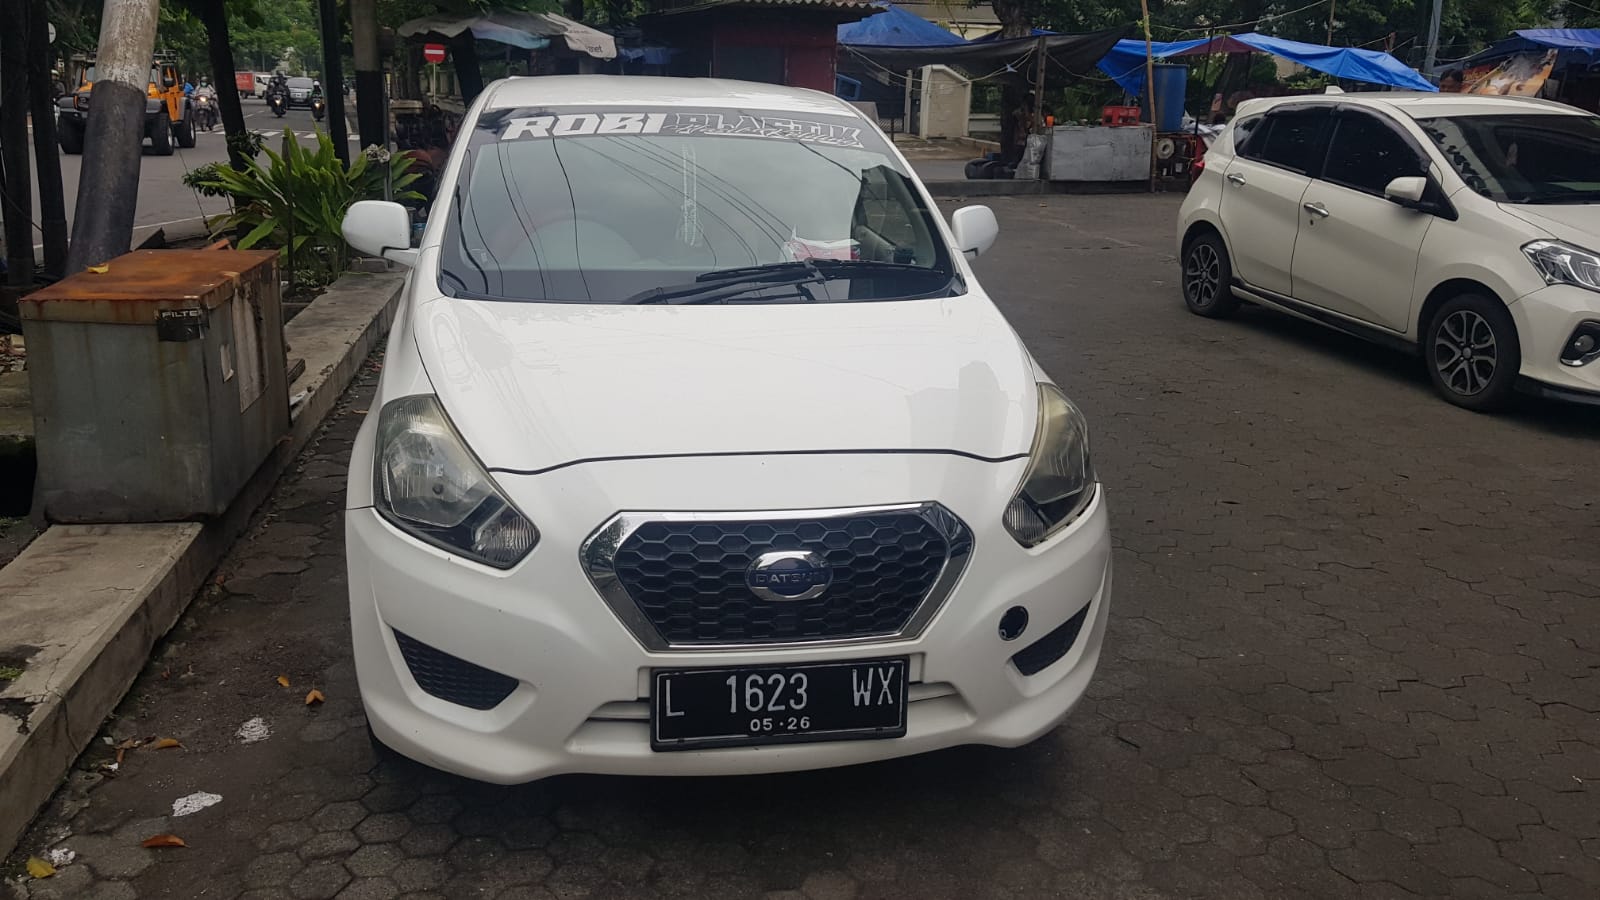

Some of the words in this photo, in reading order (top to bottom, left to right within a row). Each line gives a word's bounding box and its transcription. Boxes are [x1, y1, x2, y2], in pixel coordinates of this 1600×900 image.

[501, 112, 668, 140] ROBI
[665, 679, 685, 717] L
[726, 672, 809, 714] 1623
[851, 666, 895, 707] WX
